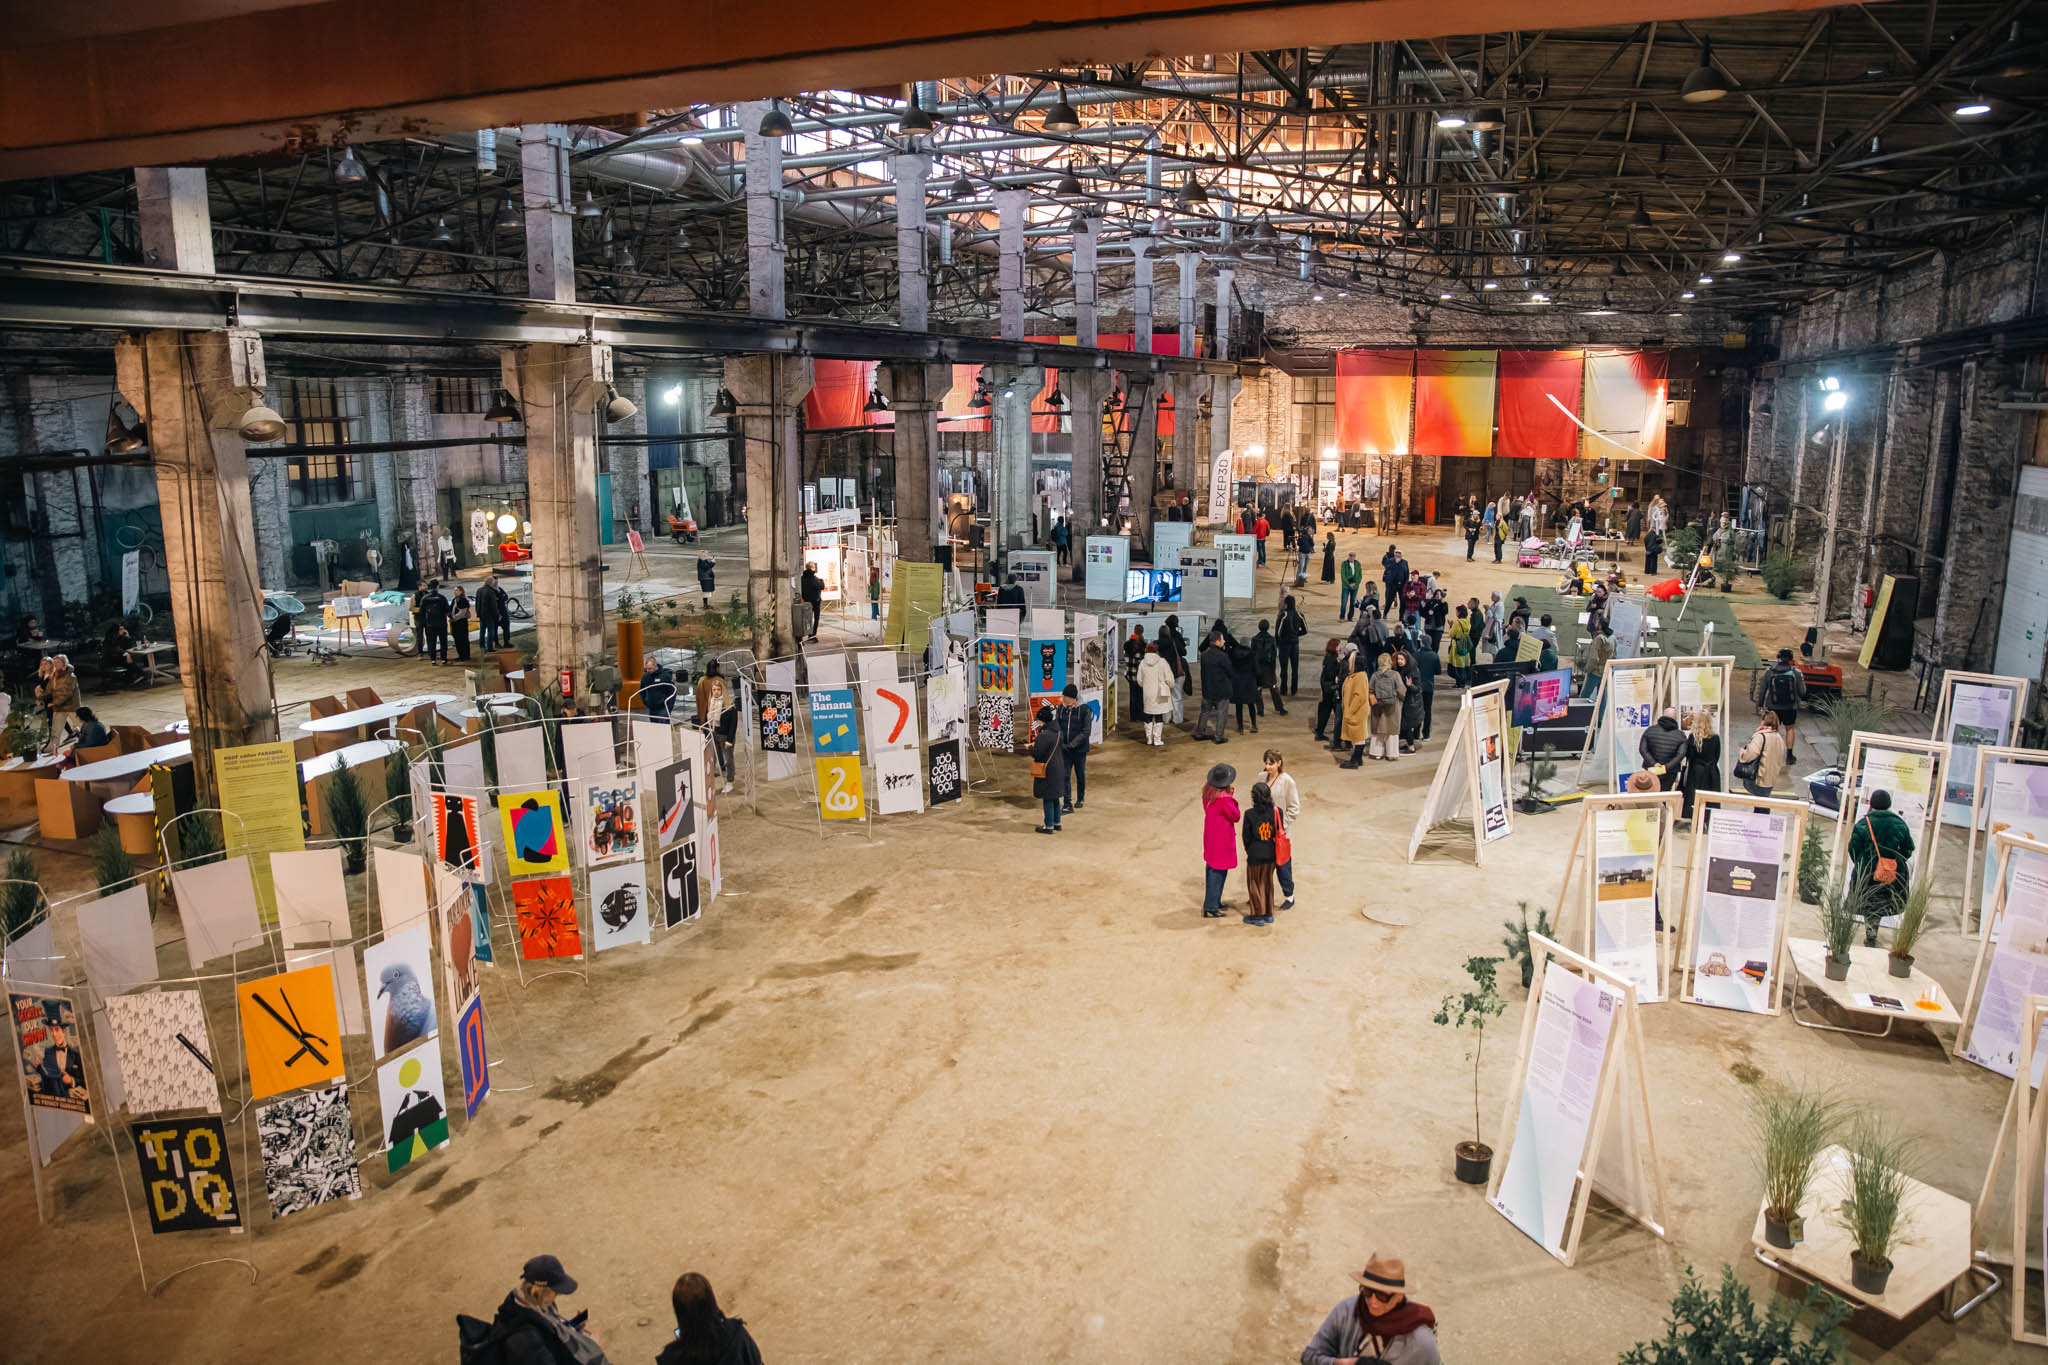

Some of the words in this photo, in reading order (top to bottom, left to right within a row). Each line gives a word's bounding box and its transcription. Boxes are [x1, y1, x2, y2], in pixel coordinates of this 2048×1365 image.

[811, 693, 831, 702] The
[813, 702, 852, 711] Banana
[588, 782, 636, 806] Feed
